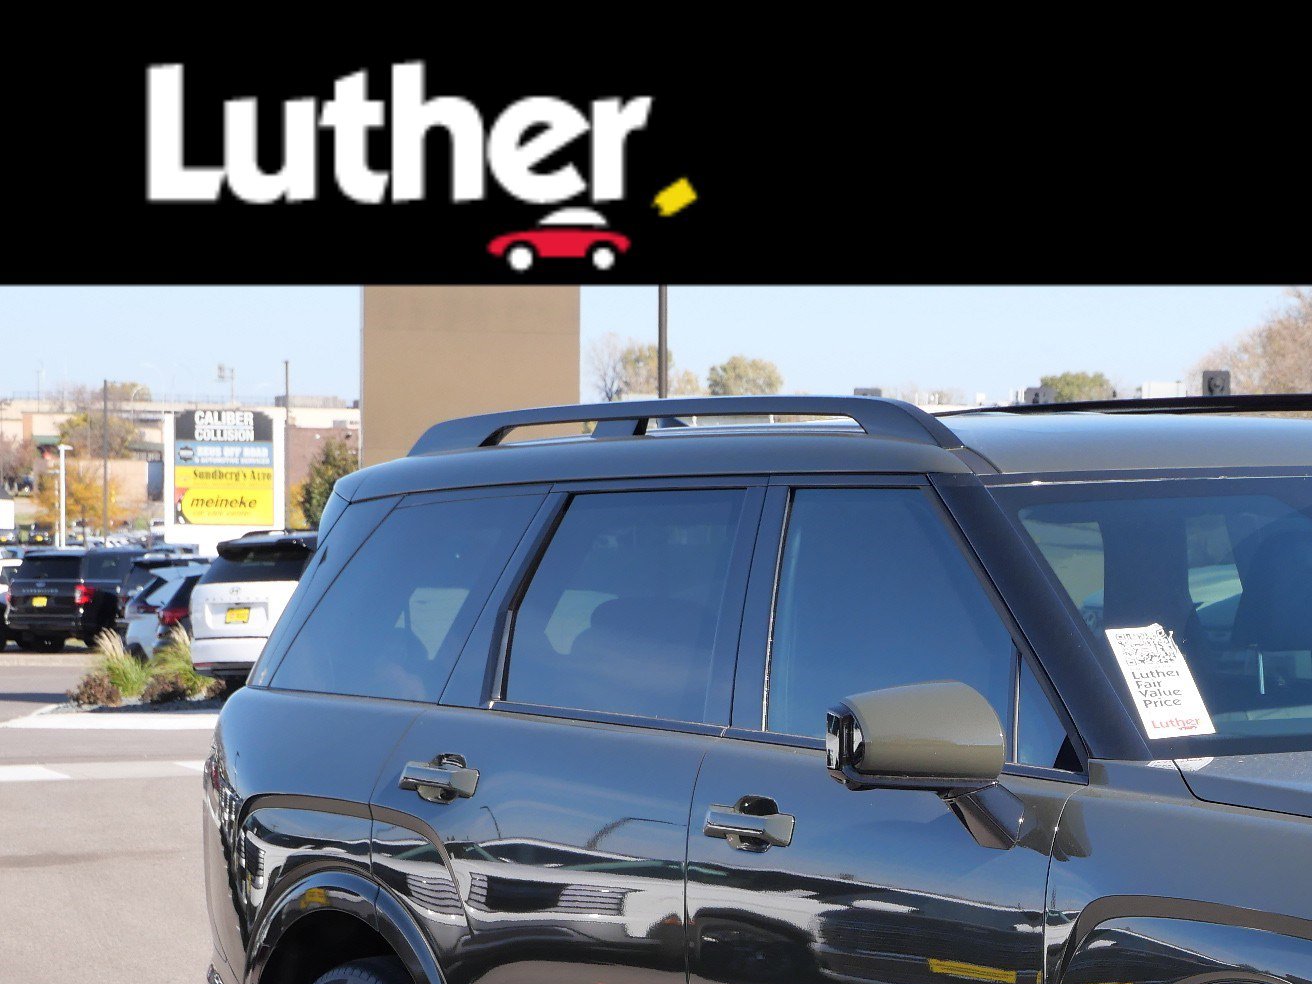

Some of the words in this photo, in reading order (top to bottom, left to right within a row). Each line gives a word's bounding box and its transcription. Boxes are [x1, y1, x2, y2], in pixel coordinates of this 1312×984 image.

[194, 410, 254, 426] CALIBER
[194, 428, 255, 441] COLLISION
[190, 495, 258, 509] meineke
[1131, 669, 1181, 680] Luther
[1135, 680, 1163, 690] Fair
[1138, 688, 1183, 699] Value
[1142, 698, 1183, 709] Price
[1151, 718, 1201, 729] Luther
